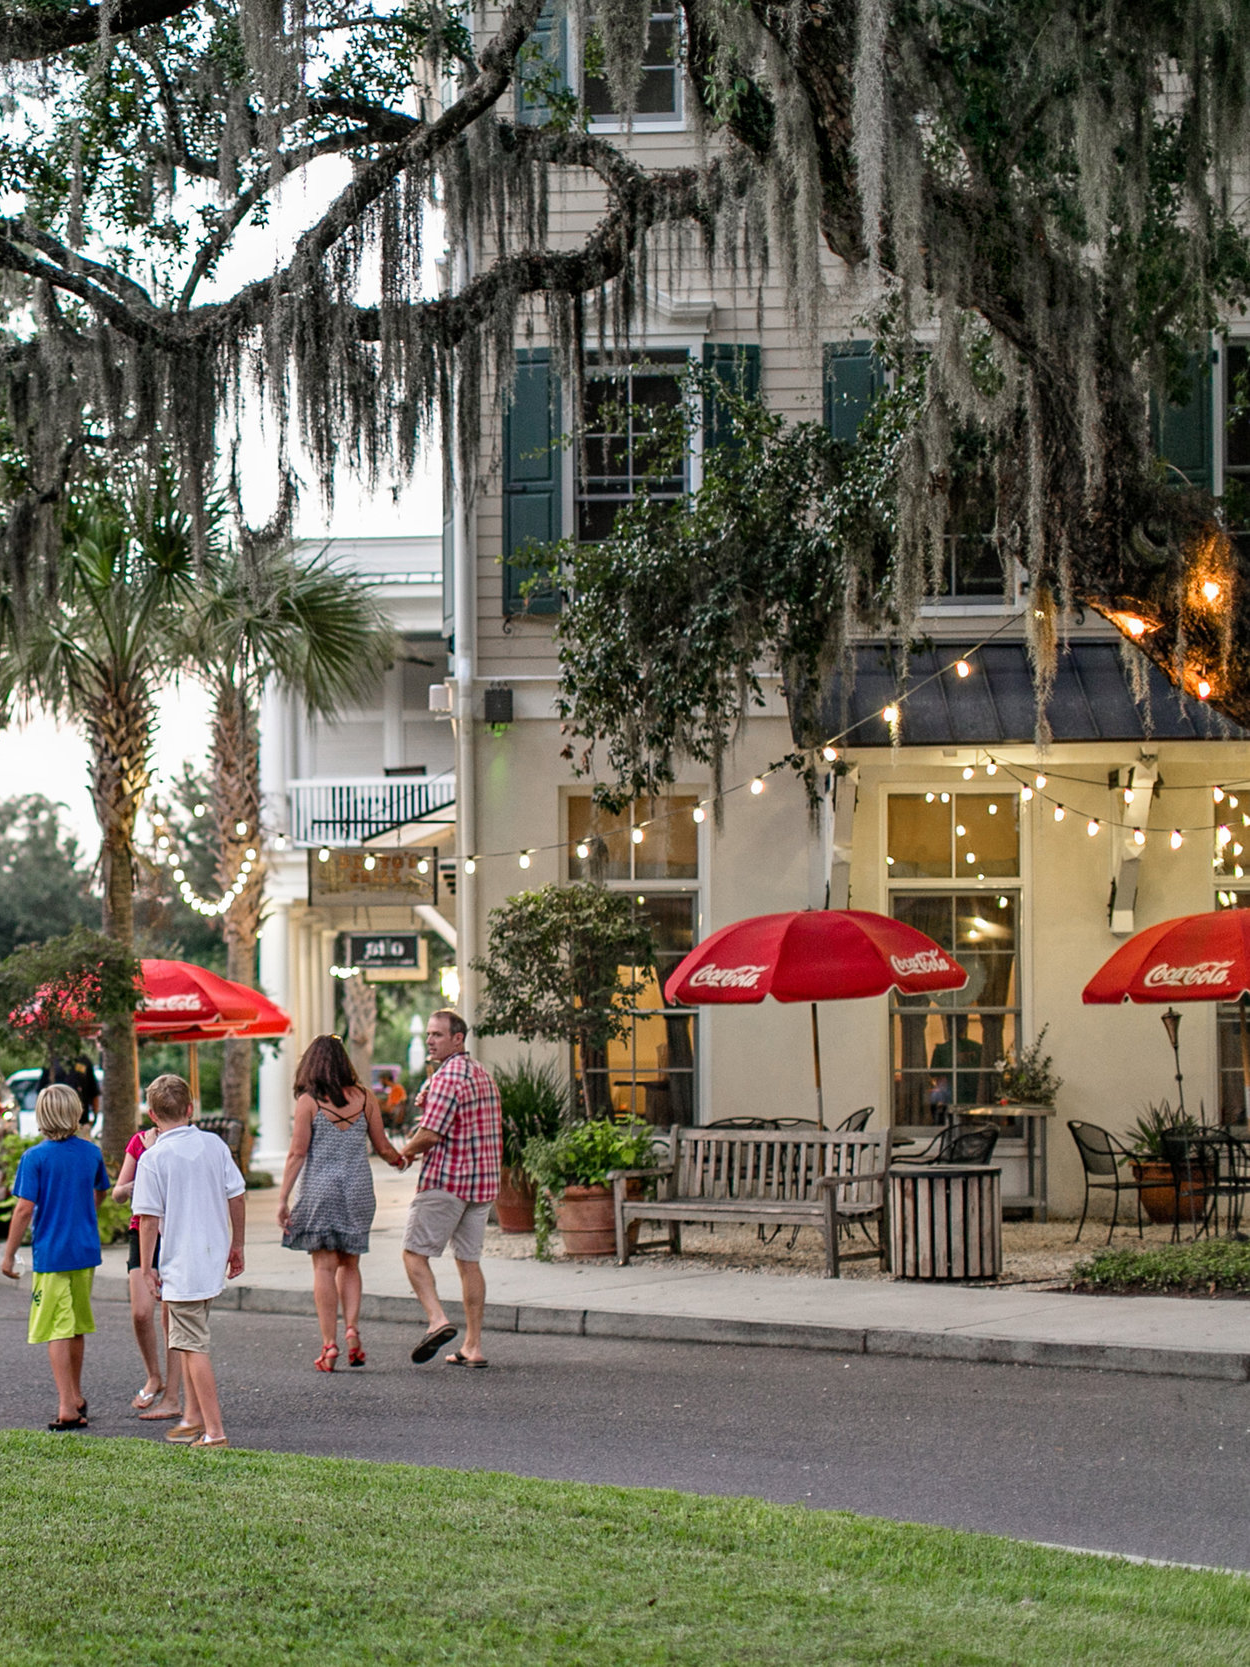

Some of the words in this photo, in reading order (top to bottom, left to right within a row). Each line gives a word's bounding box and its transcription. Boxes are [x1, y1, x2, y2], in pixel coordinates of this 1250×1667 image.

[689, 963, 770, 988] Coca-Cola
[891, 949, 950, 976] Coca-Cola
[1144, 960, 1235, 988] Coca-Cola
